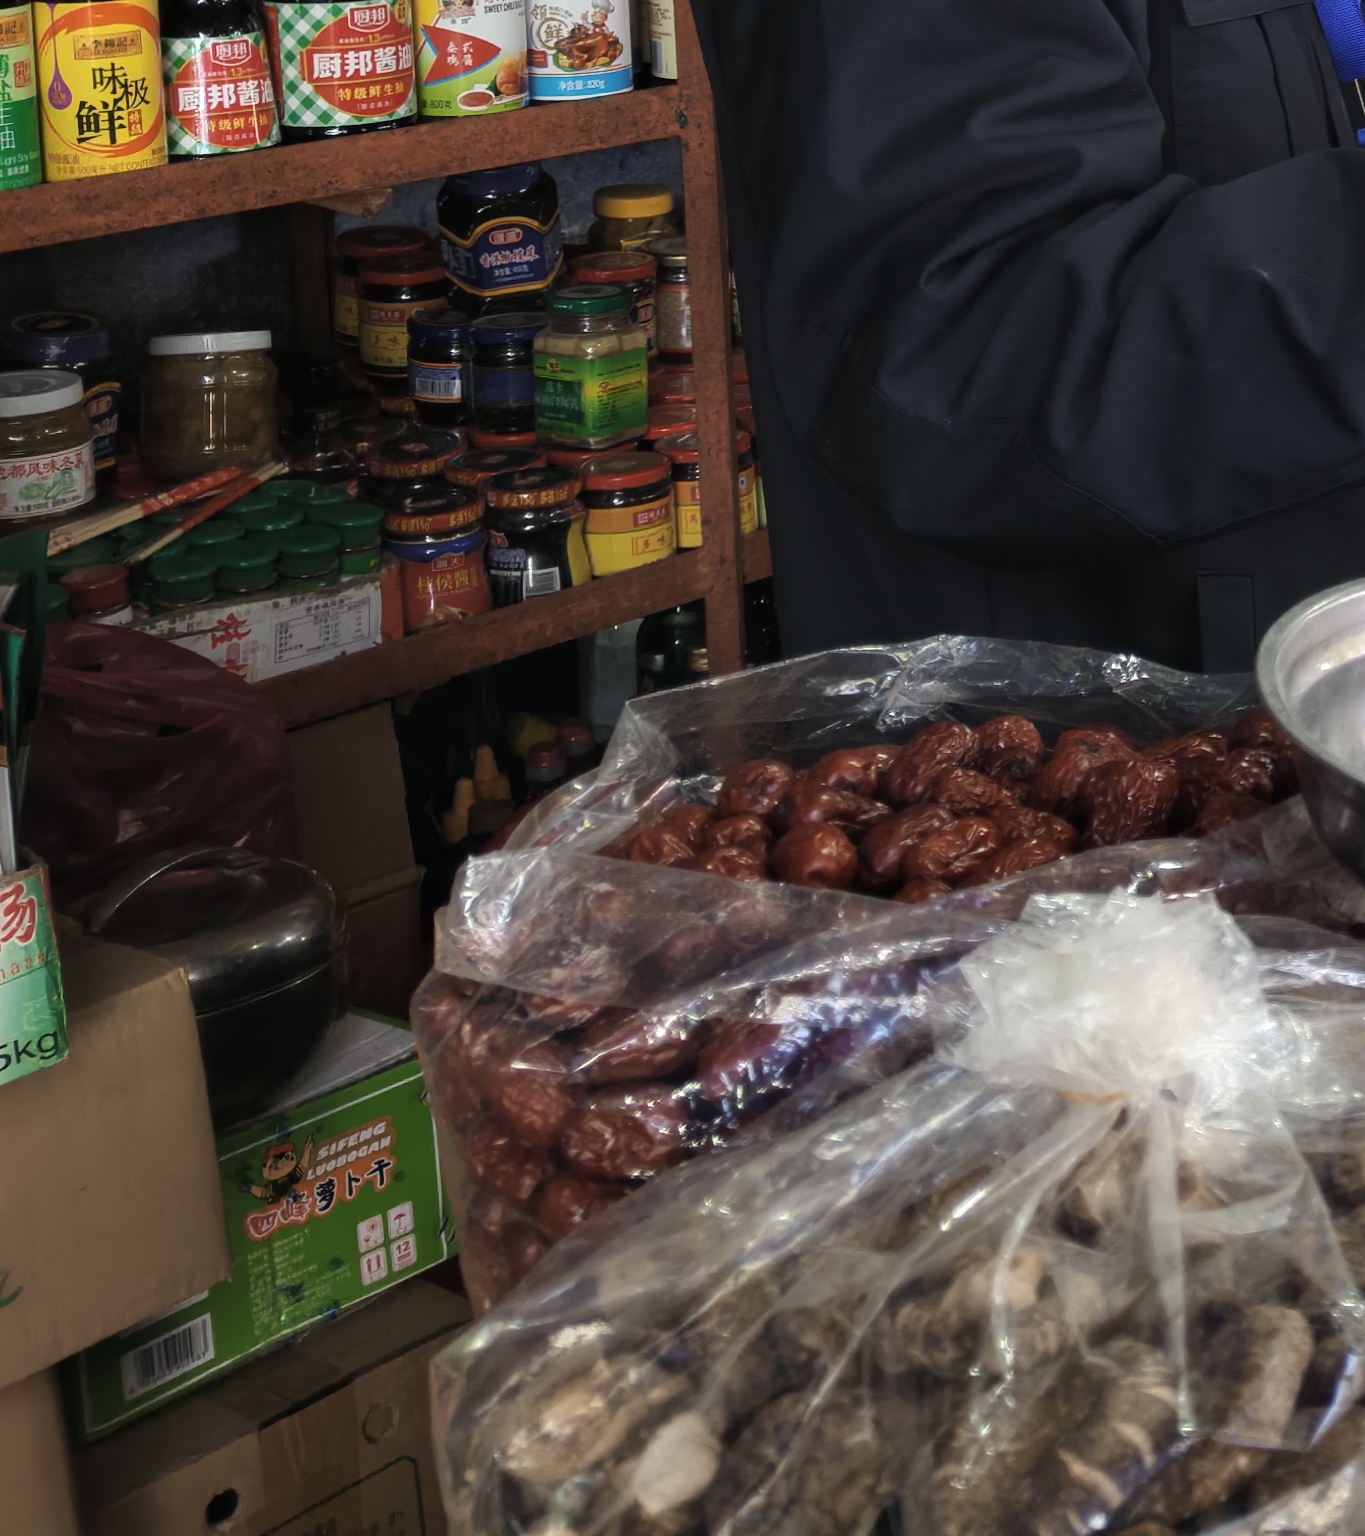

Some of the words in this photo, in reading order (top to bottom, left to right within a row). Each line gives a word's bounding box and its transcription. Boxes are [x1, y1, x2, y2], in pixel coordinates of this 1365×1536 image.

[352, 8, 387, 26] 厨邦
[543, 23, 565, 44] 鲜
[215, 44, 249, 61] 厨邦
[312, 44, 412, 81] 厨邦酱油
[177, 78, 275, 113] 厨邦酱油
[336, 80, 405, 103] 特级鲜生抽
[306, 1135, 392, 1181] LUOBOGAN
[316, 1120, 388, 1162] SIFENG
[247, 1156, 393, 1239] 四峰萝卜干
